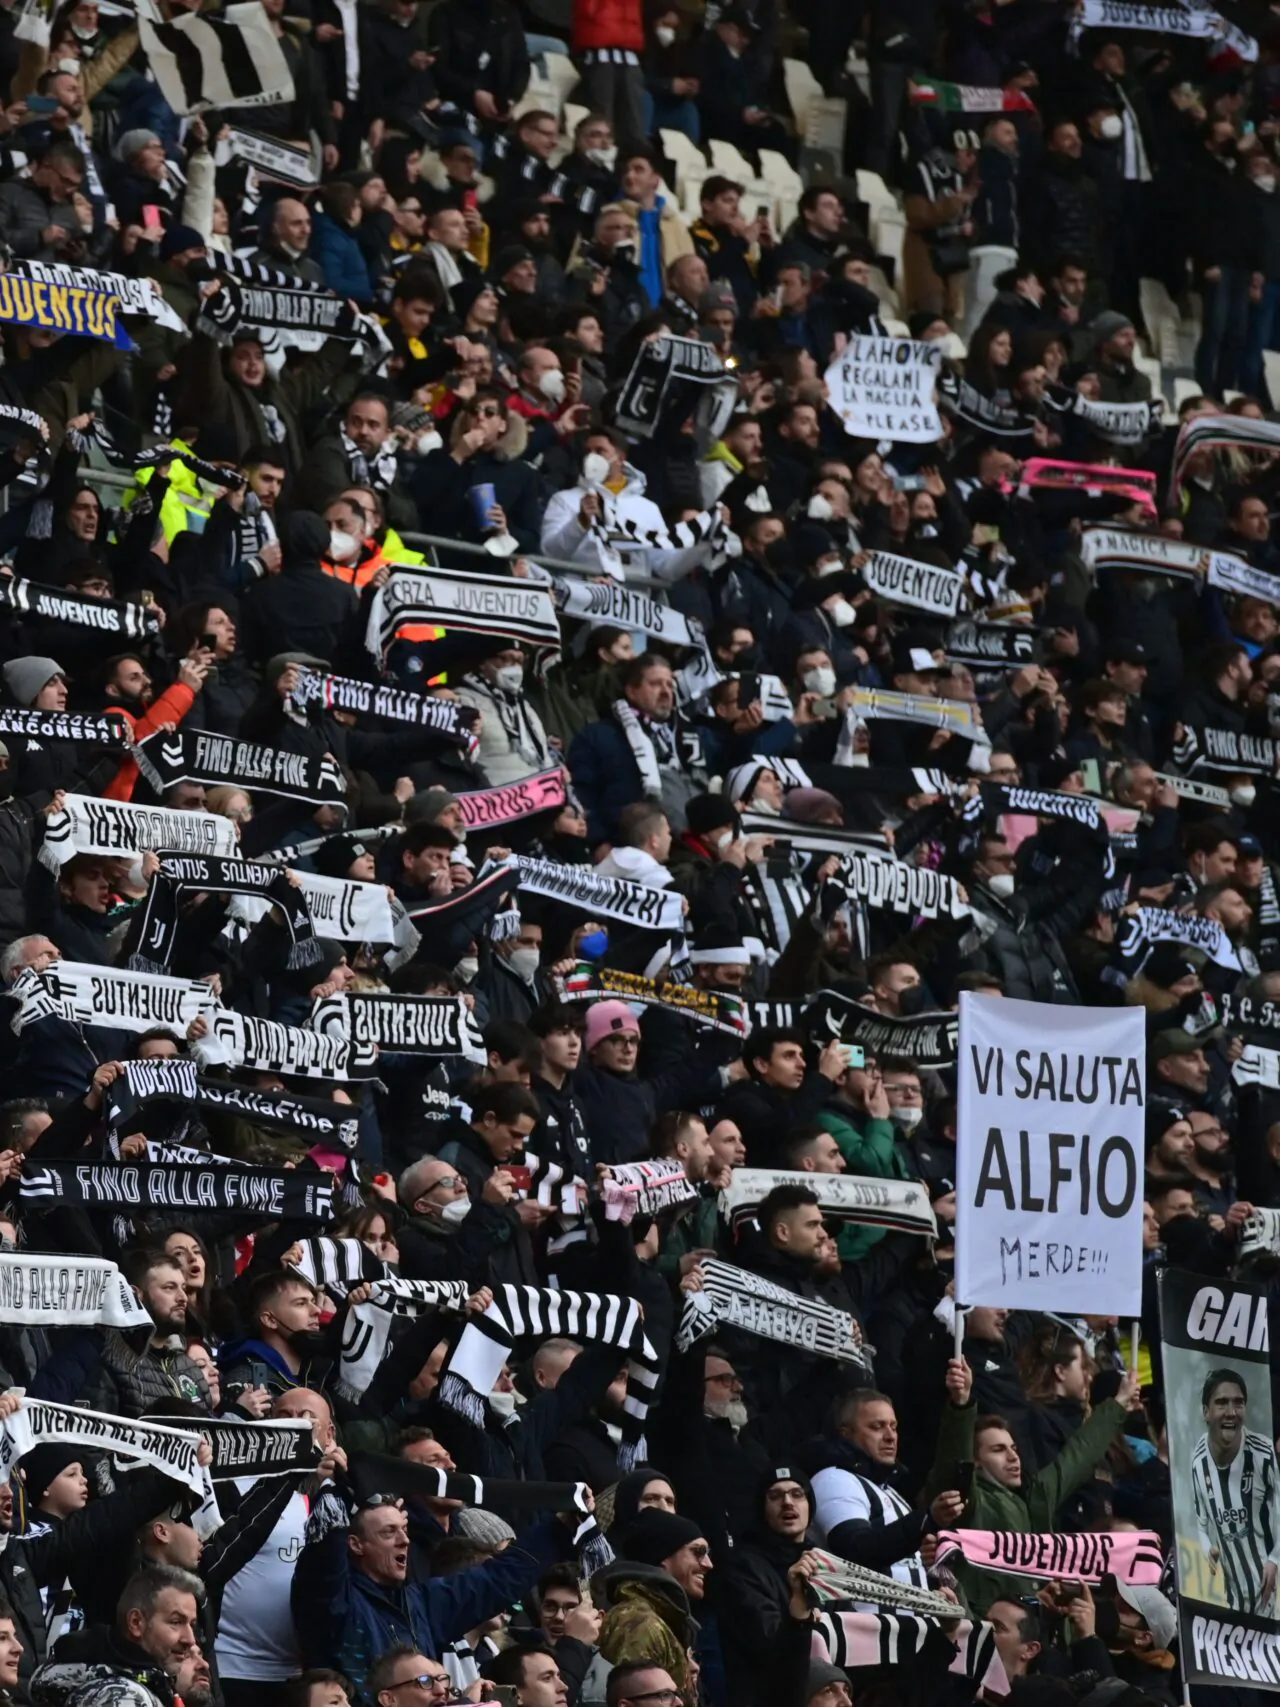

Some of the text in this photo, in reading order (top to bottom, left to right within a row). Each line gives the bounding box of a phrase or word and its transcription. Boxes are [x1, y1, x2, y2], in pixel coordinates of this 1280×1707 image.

[865, 414, 936, 433] PLEASE
[1104, 538, 1168, 558] MAGICA
[453, 588, 540, 618] JUVENTUS
[871, 552, 960, 608] JUVENTUS
[36, 593, 121, 632] JUVENTUS
[585, 586, 664, 634] JUVENTUS
[330, 682, 461, 734] FINO ALLA FINE
[194, 735, 310, 788] FINO ALLA FINE
[1204, 726, 1275, 766] FINO ALLA
[422, 1084, 450, 1110] Jeep
[971, 1044, 1144, 1107] VI SALUTA
[76, 1165, 141, 1203] FINO
[147, 1169, 216, 1208] ALLA
[223, 1174, 285, 1214] FINE
[974, 1127, 1138, 1219] ALFIO
[999, 1236, 1109, 1286] MERDE!!!
[28, 1266, 69, 1311] ALLA
[71, 1268, 113, 1311] FINE
[111, 1423, 138, 1447] NEL
[141, 1428, 197, 1477] SANGUE
[217, 1429, 301, 1466] ALLA FINE
[989, 1530, 1115, 1578] JUVENTUS
